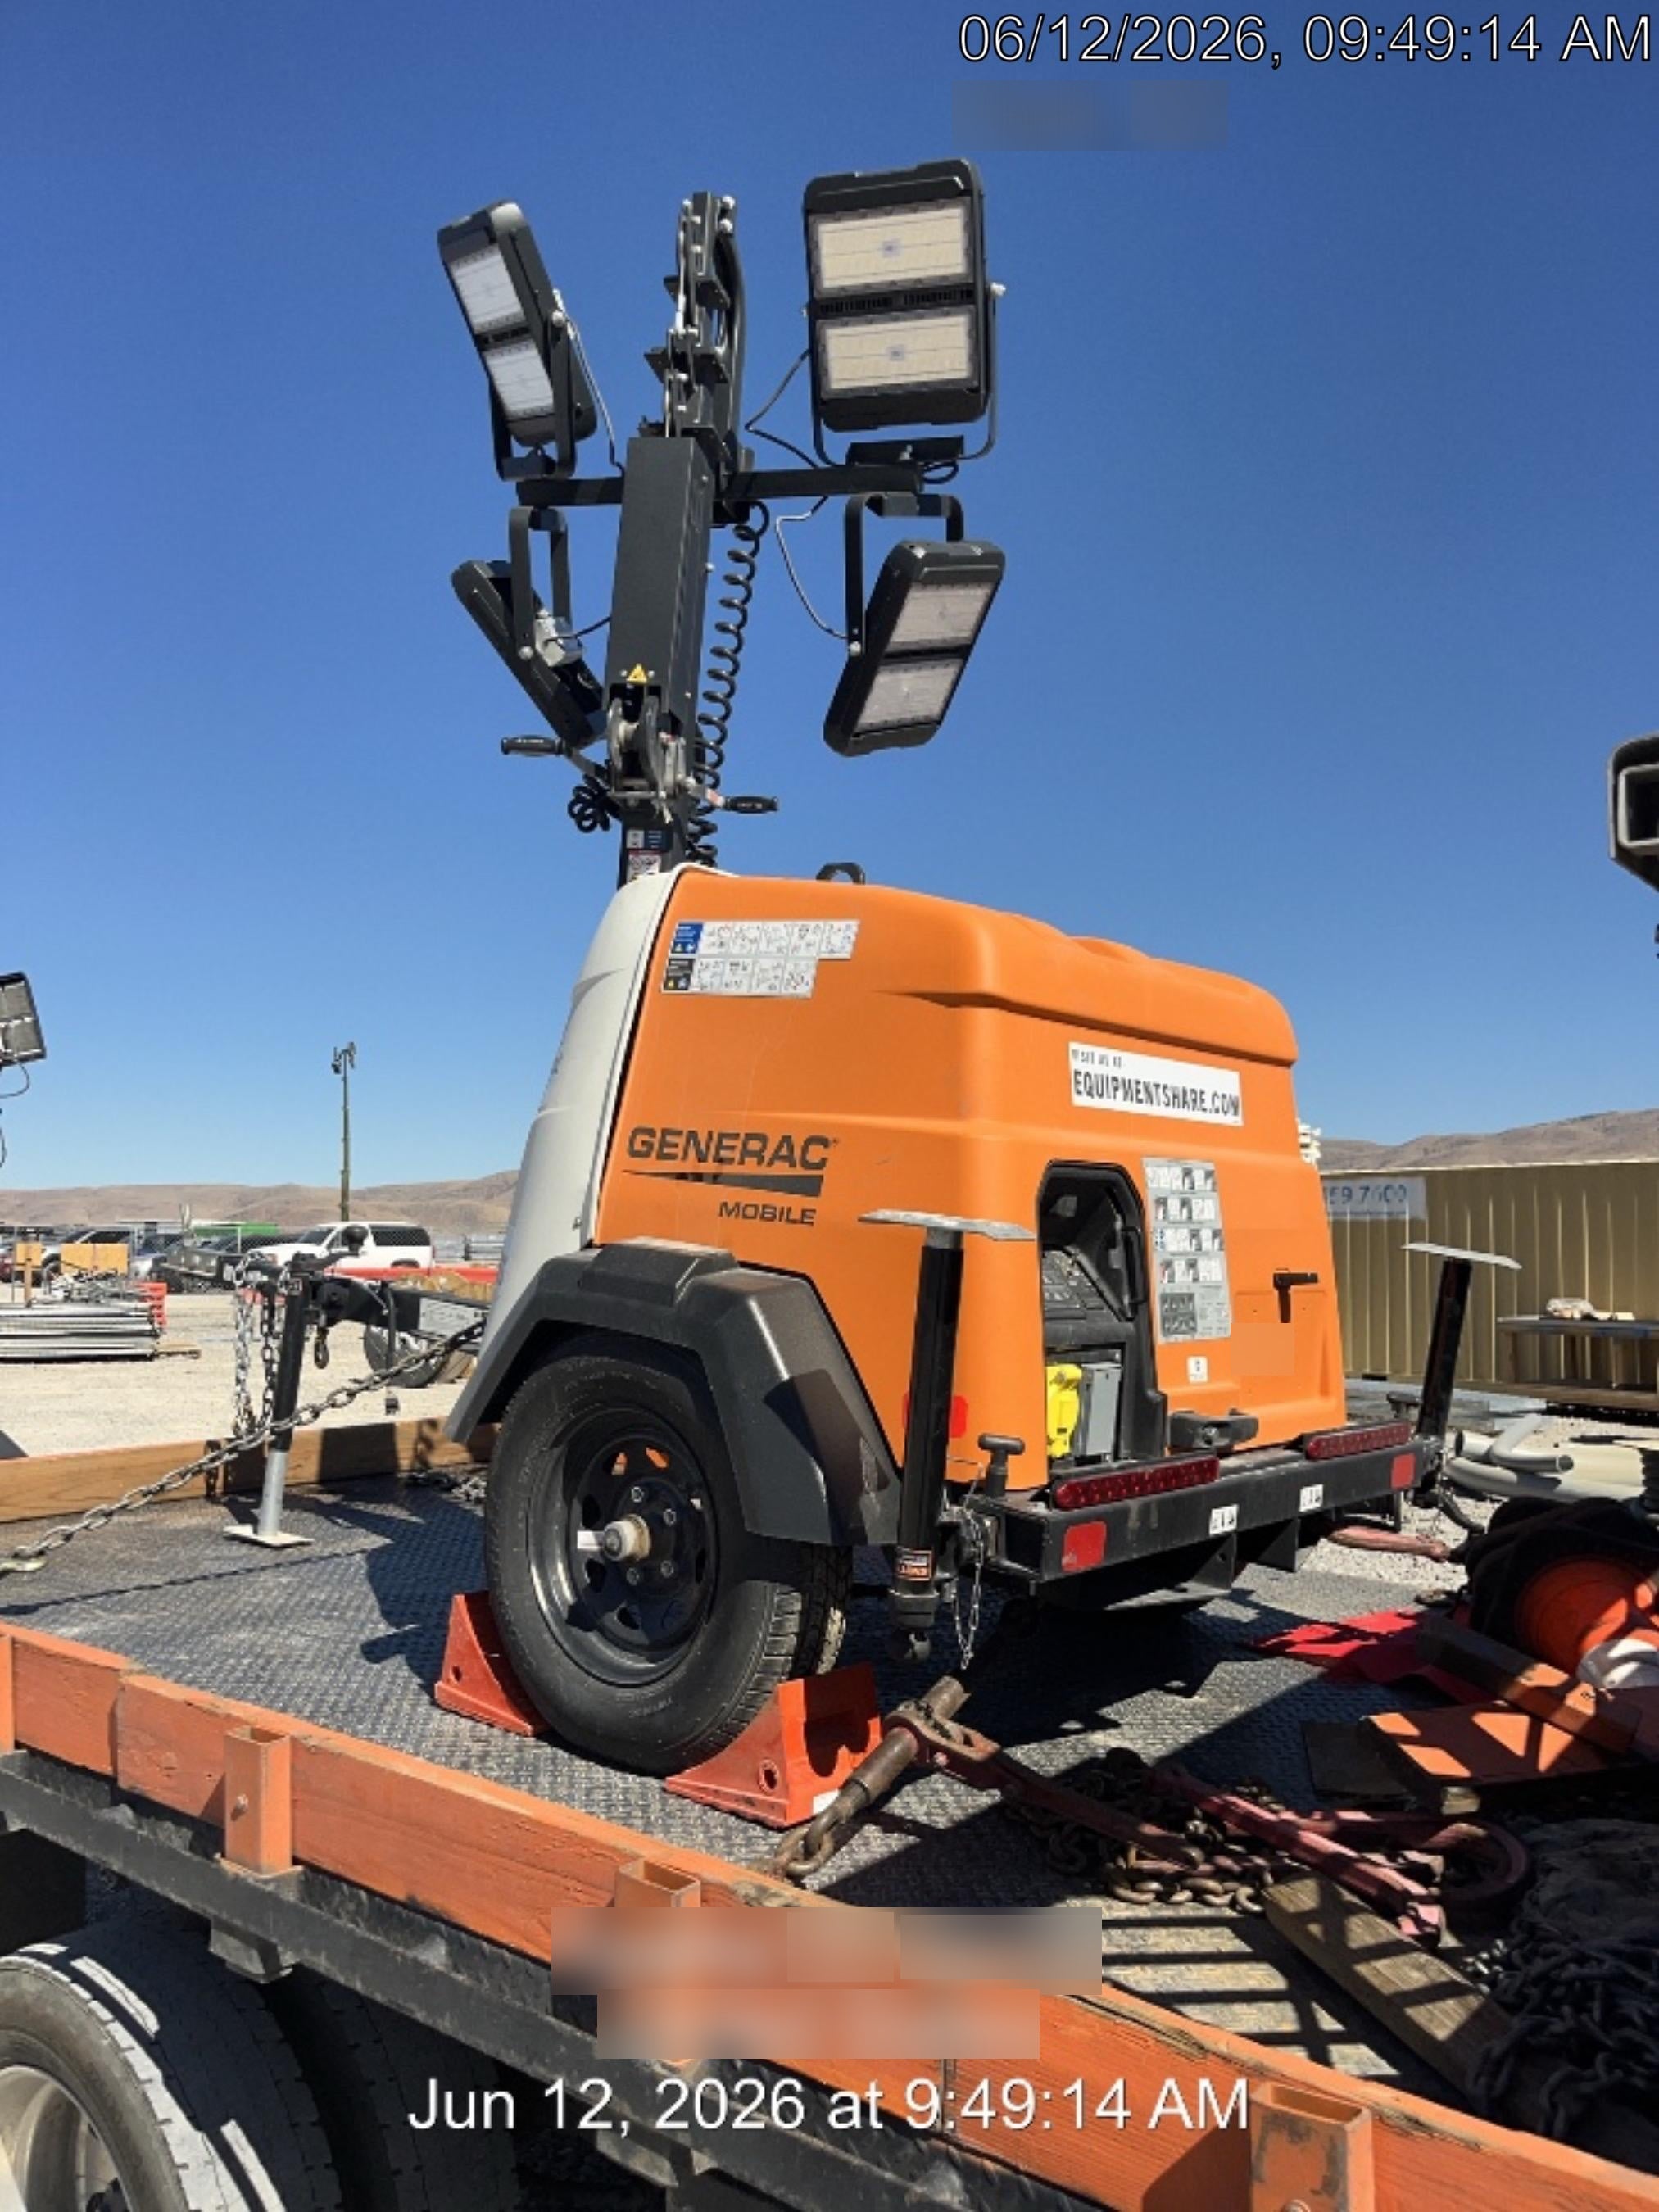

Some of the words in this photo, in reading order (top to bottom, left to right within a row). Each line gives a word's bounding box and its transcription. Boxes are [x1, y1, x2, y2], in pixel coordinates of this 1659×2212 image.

[1073, 1068, 1240, 1117] EQUIPMENTSHARE.COM
[628, 1126, 831, 1171] GENERAC
[718, 1201, 817, 1226] MOBILE
